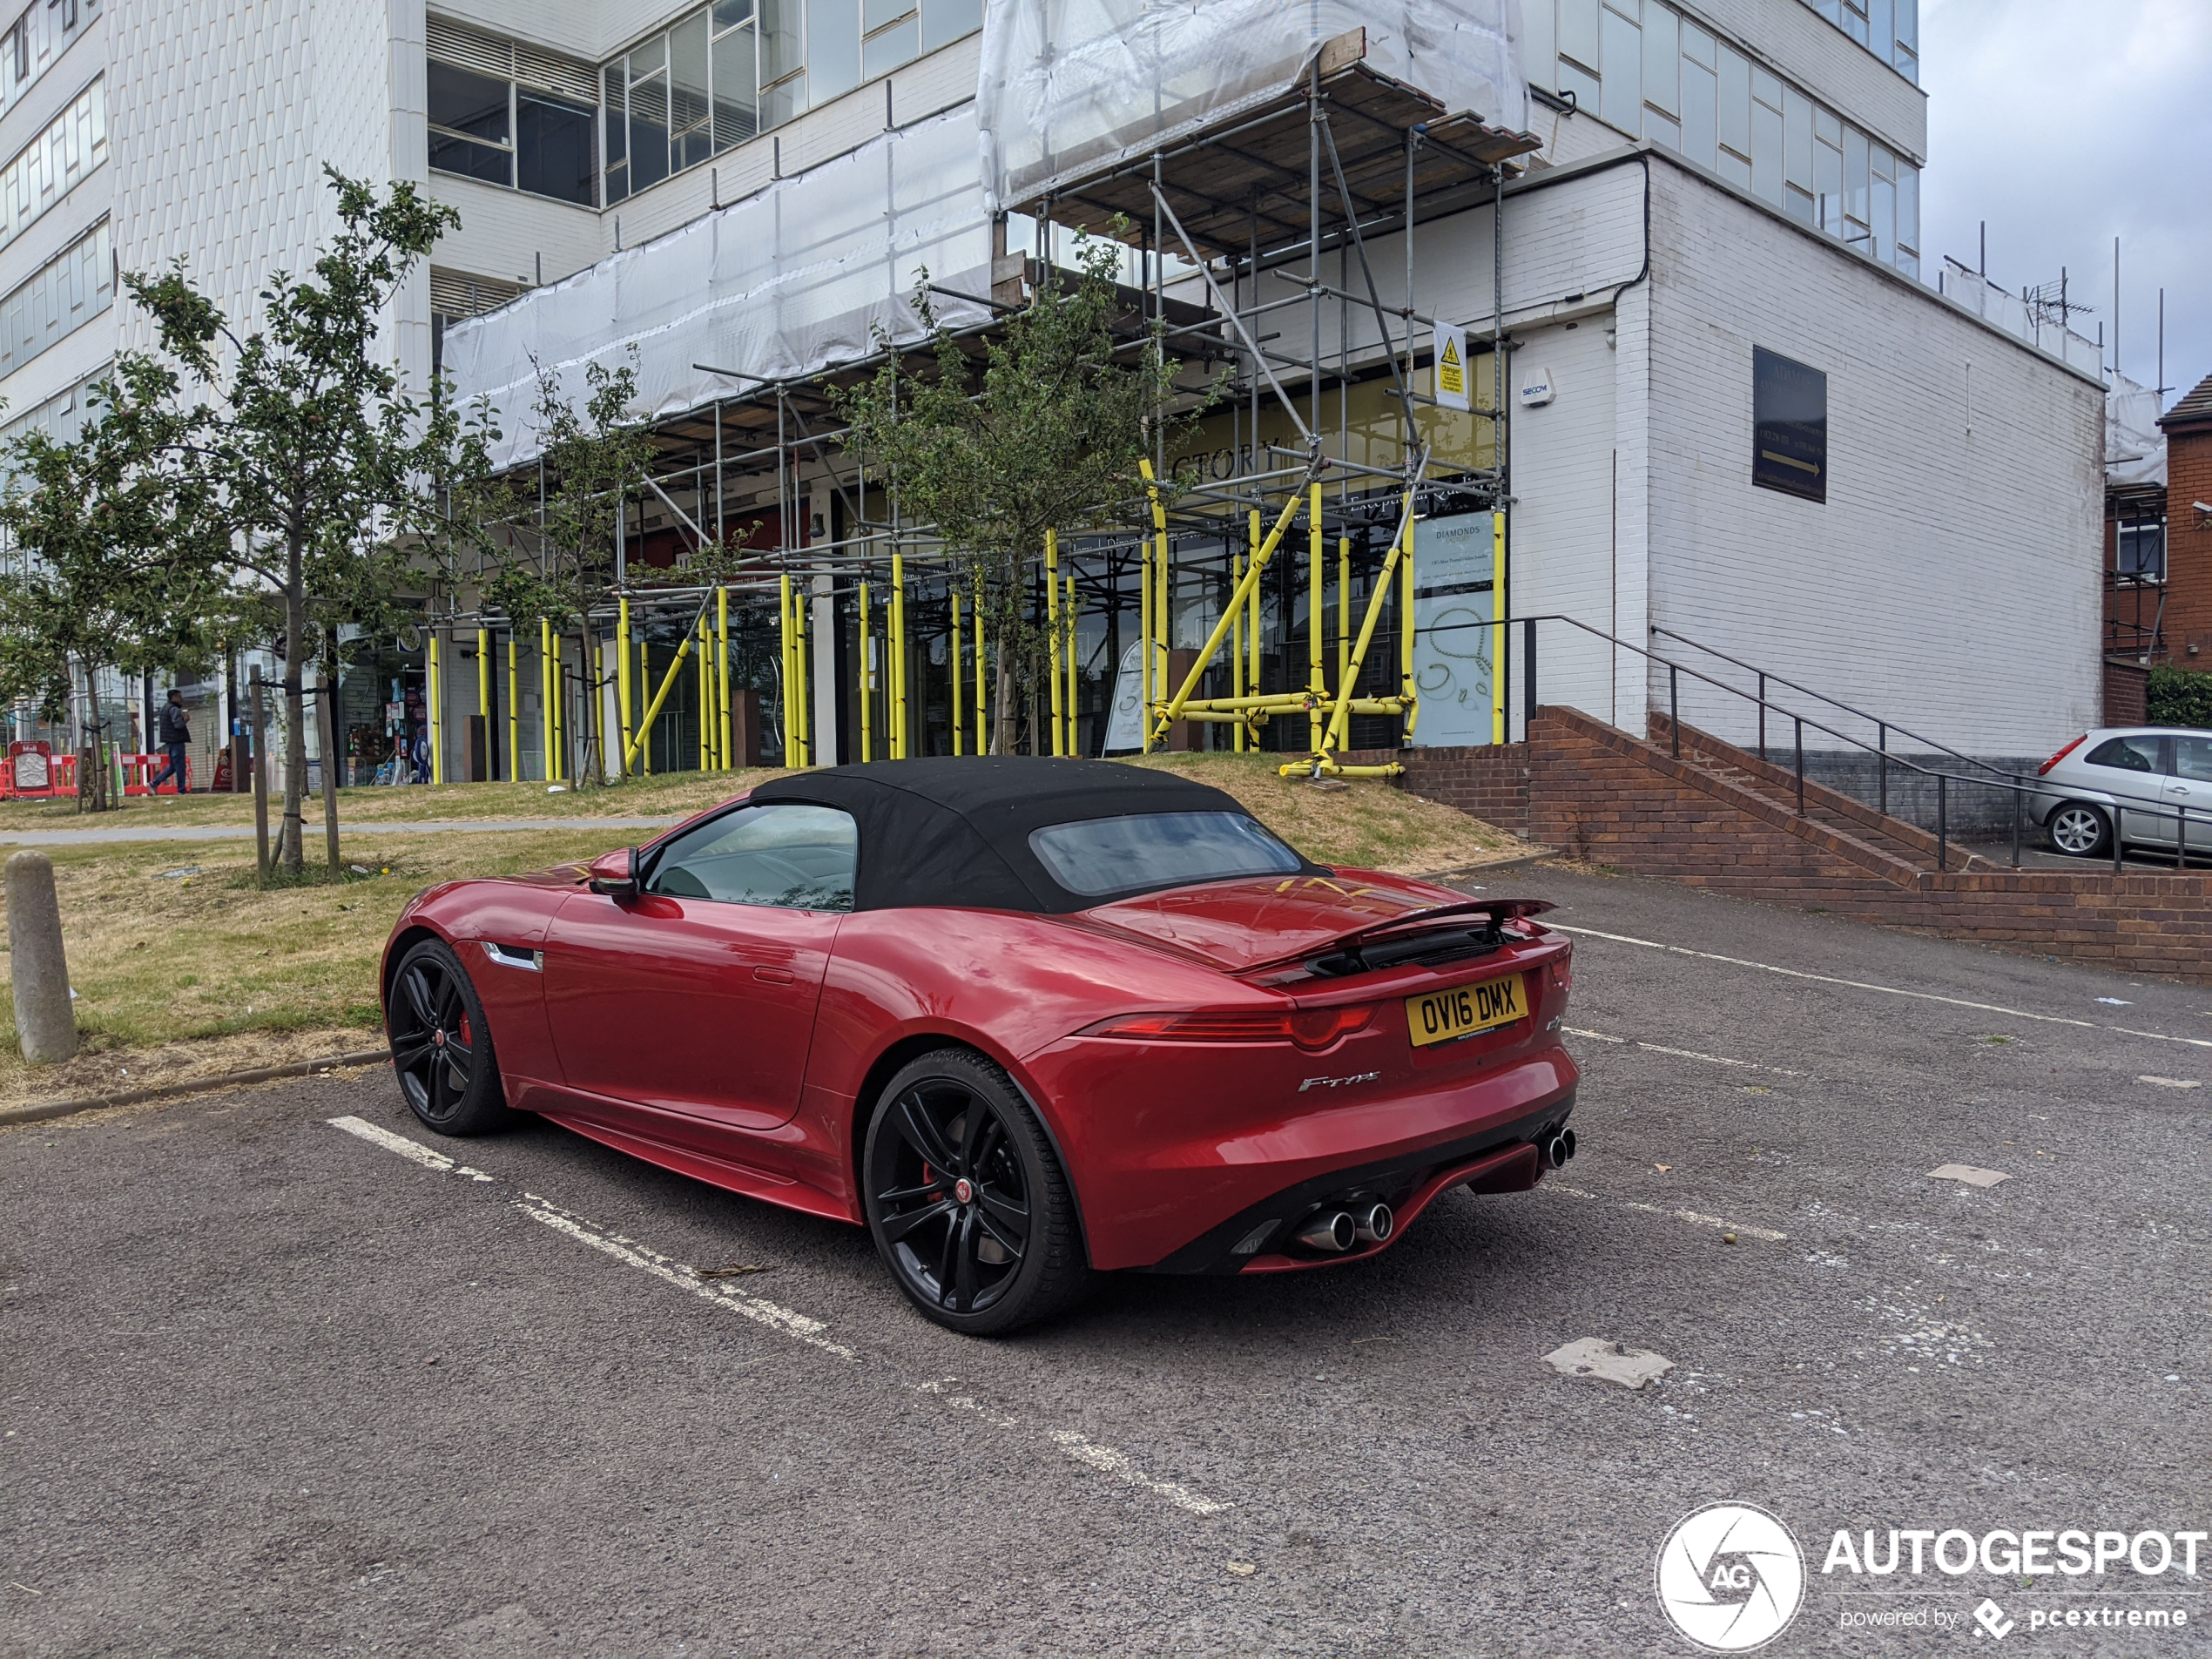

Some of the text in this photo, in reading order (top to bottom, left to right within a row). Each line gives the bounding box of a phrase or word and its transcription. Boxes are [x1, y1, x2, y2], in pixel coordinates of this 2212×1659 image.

[1441, 365, 1460, 374] Danger
[1523, 385, 1547, 395] SECOM
[1172, 438, 1279, 484] CTORY
[1436, 526, 1480, 539] DIAMONDS
[1421, 980, 1516, 1034] OV16 DMX
[1298, 1071, 1380, 1092] F-TYPE
